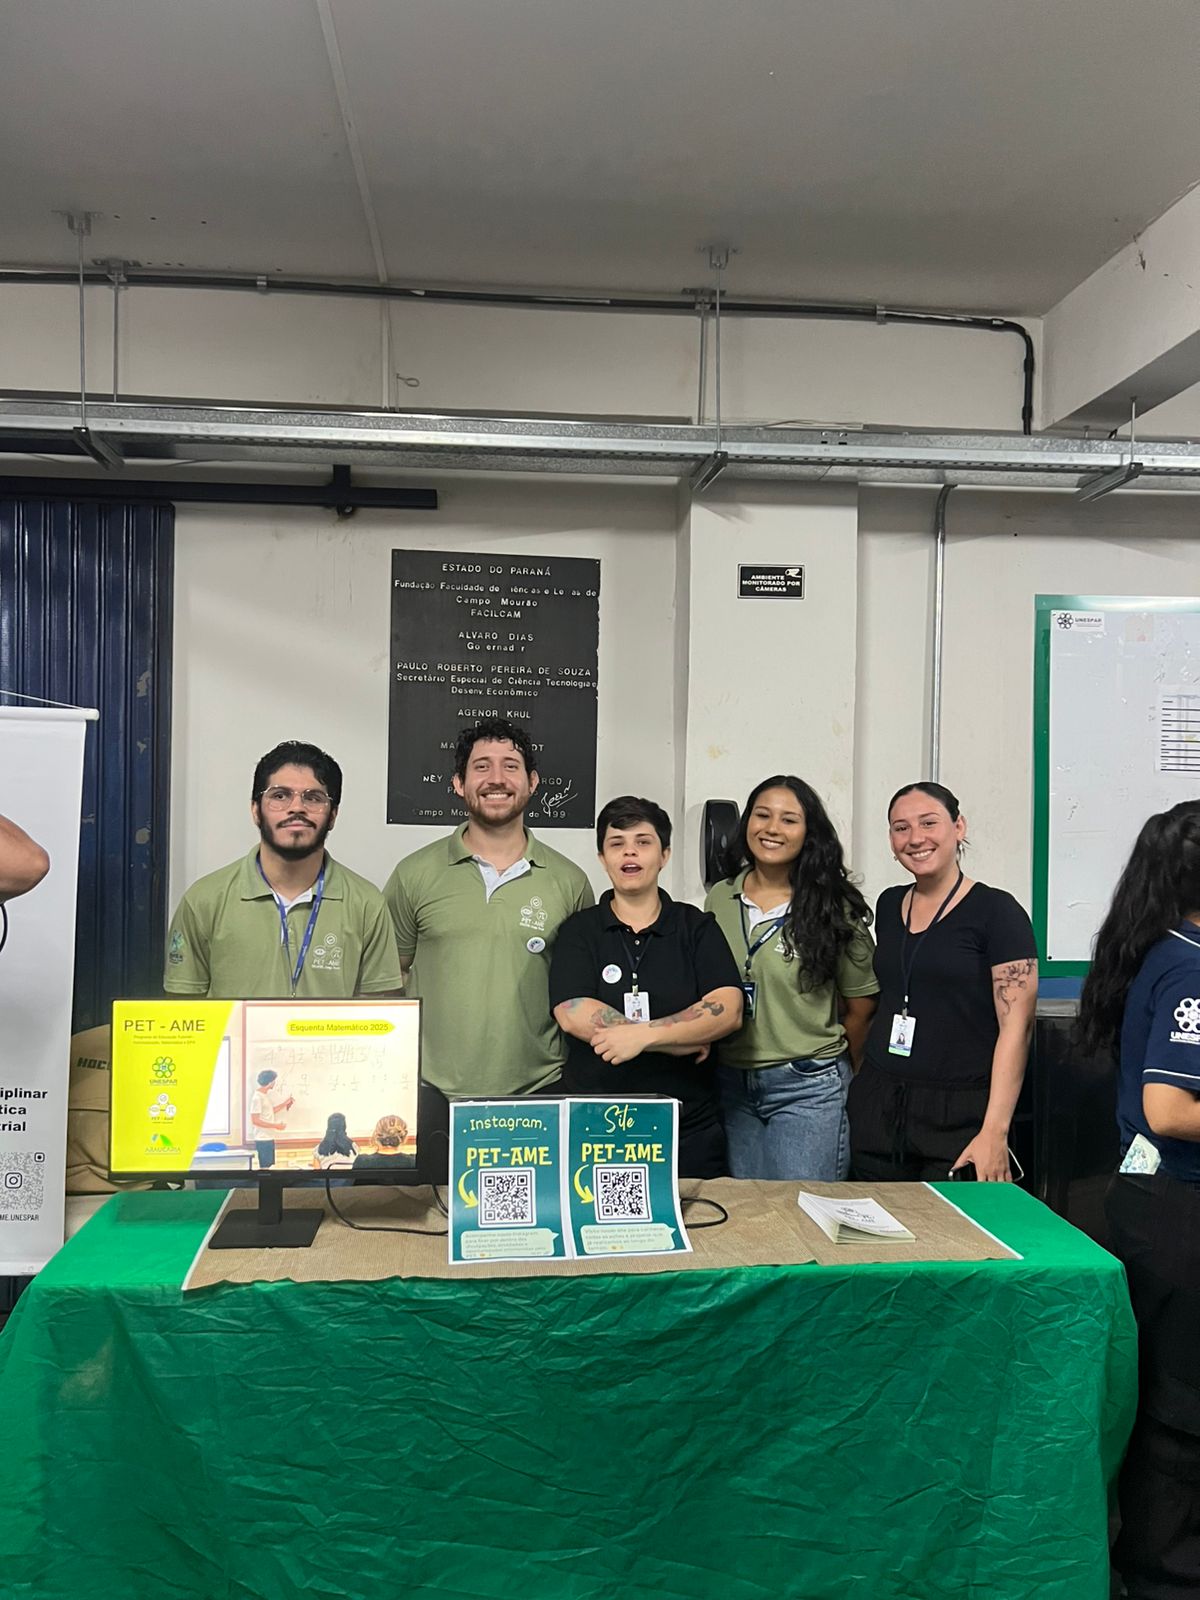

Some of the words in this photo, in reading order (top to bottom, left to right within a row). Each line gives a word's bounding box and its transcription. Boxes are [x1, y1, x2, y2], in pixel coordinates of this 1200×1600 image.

[442, 563, 482, 573] ESTADO
[489, 565, 503, 574] DO
[510, 566, 551, 576] PARANÁ
[394, 579, 435, 590] Fundação
[440, 581, 485, 592] Faculdade
[489, 584, 500, 592] de
[507, 586, 541, 594] iêncas
[553, 587, 581, 596] Leas
[585, 589, 597, 597] de
[755, 585, 787, 593] CÂMERAS
[456, 596, 491, 606] Campo
[500, 597, 538, 607] Mourão
[471, 609, 521, 618] FACILCAM
[458, 632, 498, 640] ALVARO
[509, 633, 534, 642] DIAS
[467, 642, 526, 652] Goernadr
[397, 662, 429, 671] PAULO
[437, 663, 483, 673] ROBERTO
[491, 665, 532, 674] PEREIRA
[538, 666, 551, 675] DE
[558, 667, 591, 676] SOUZA
[396, 673, 446, 682] Secretário
[450, 675, 487, 684] Especial
[491, 676, 503, 685] de
[508, 677, 541, 686] Ciência
[486, 687, 539, 697] Econômico
[458, 709, 499, 718] AGENOR
[506, 710, 531, 719] KRUL
[423, 774, 443, 783] NEY
[541, 777, 563, 785] RGO
[414, 809, 444, 818] ampo
[451, 808, 470, 817] Mou
[124, 1019, 156, 1032] PET
[169, 1019, 206, 1032] AME
[290, 1023, 325, 1033] Esquenta
[326, 1023, 369, 1032] Matemático
[370, 1023, 389, 1032] 2025
[0, 1087, 48, 1101] iplinar
[0, 1104, 26, 1115] tica
[469, 1115, 543, 1131] Instagram
[604, 1104, 638, 1134] Site
[0, 1121, 26, 1132] rial
[466, 1145, 553, 1167] PET-AME
[582, 1142, 666, 1163] PET-AME
[0, 1213, 40, 1222] ME.UNESPAR
